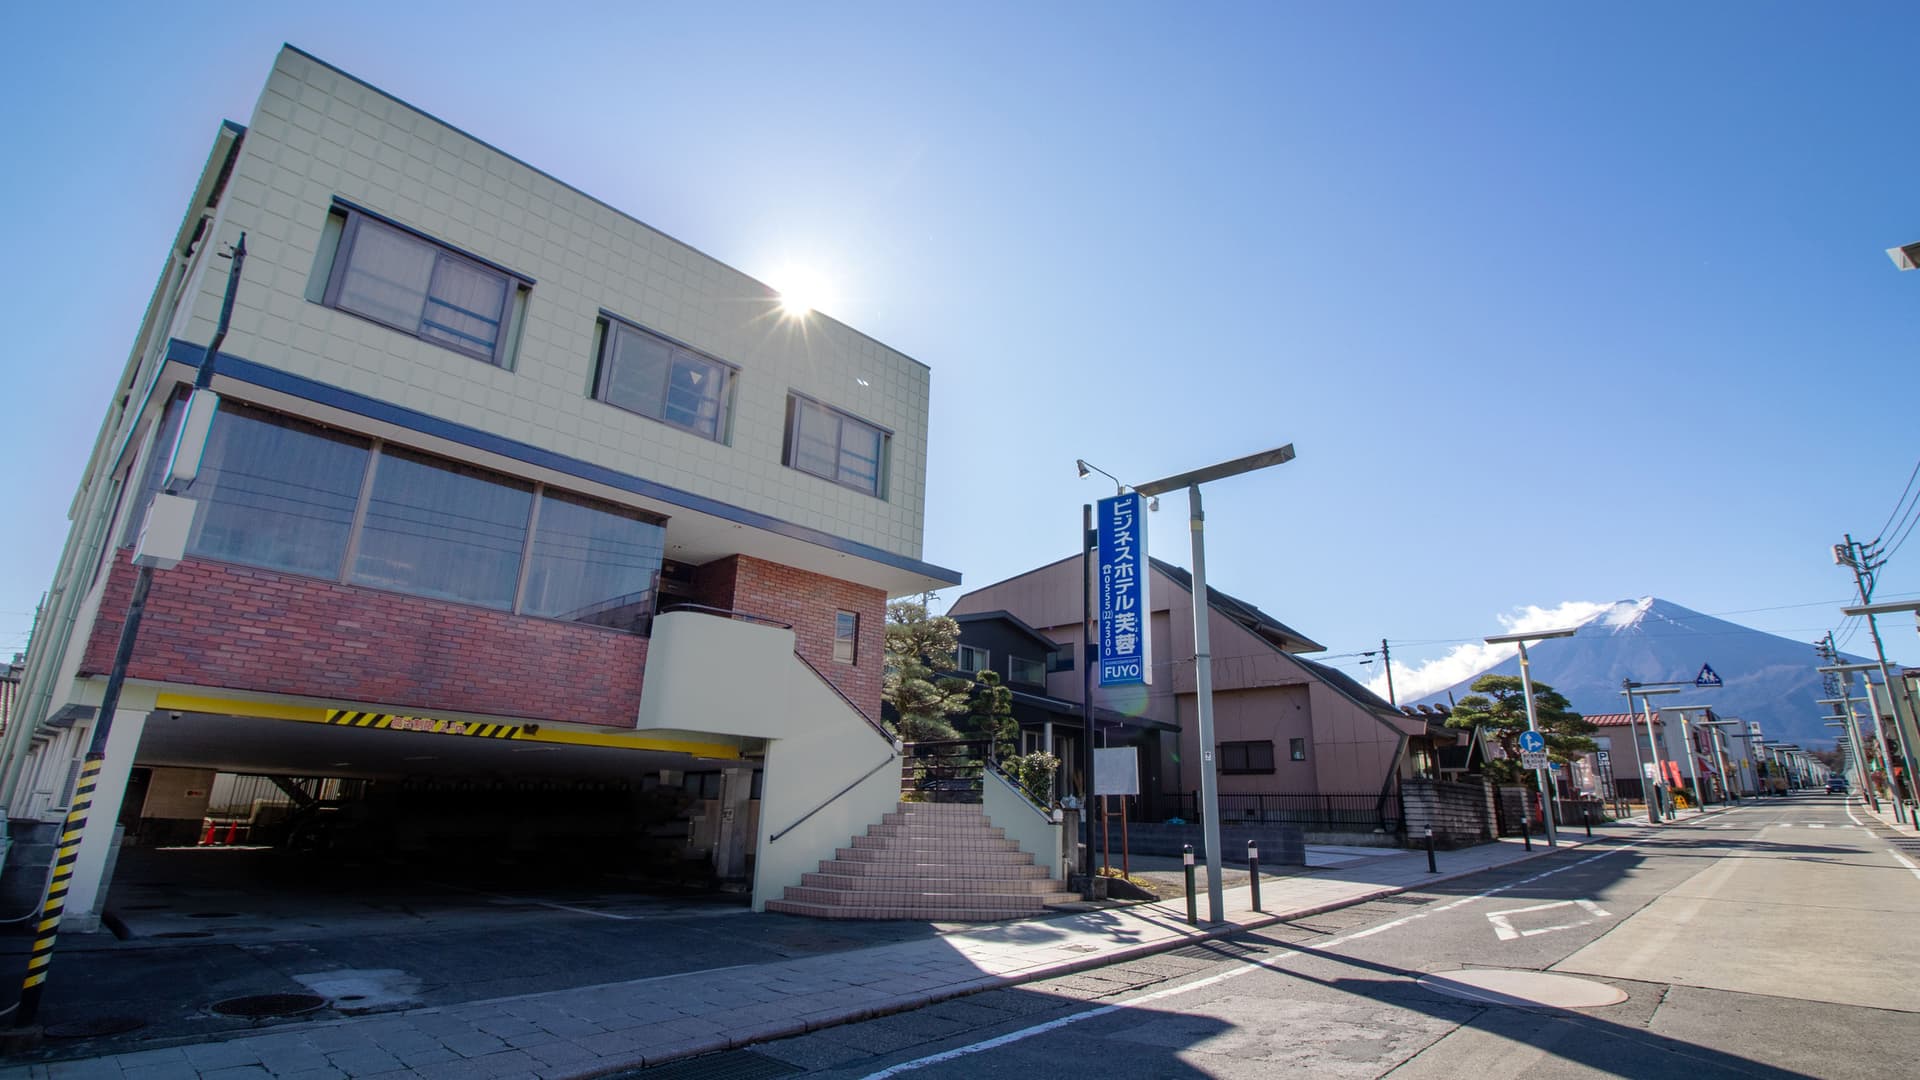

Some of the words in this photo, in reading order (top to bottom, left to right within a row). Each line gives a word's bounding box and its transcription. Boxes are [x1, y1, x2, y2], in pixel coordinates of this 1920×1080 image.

[1114, 498, 1136, 655] ビジネスホテル芙蓉
[1104, 664, 1140, 679] FUYO
